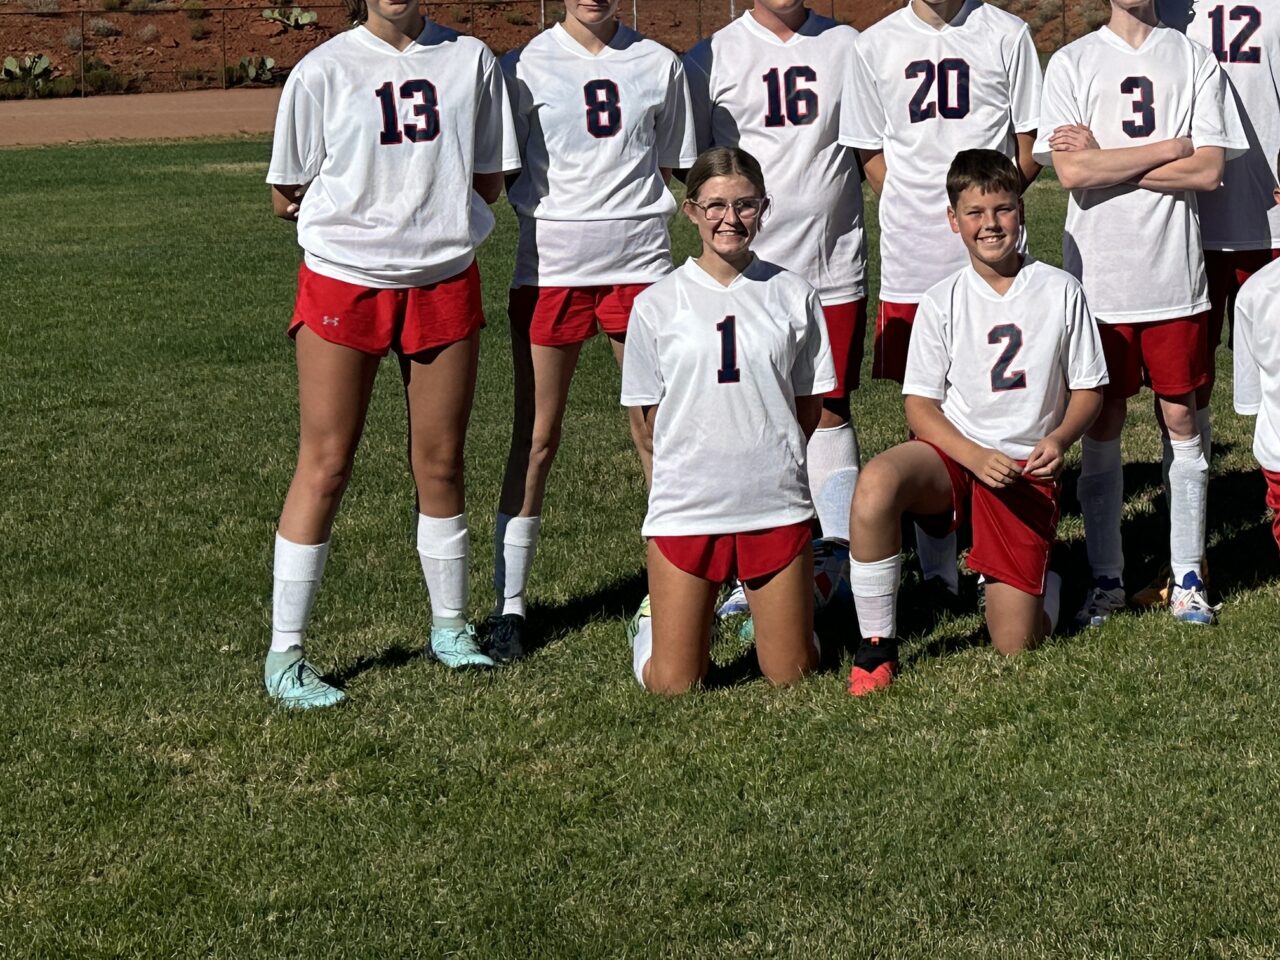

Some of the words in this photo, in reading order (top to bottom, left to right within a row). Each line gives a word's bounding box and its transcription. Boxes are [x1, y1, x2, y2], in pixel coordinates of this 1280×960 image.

[1207, 4, 1262, 64] 12
[374, 78, 441, 146] 13
[583, 78, 622, 139] 8
[762, 65, 819, 128] 16
[904, 57, 970, 124] 20
[1120, 76, 1156, 139] 3
[716, 315, 741, 384] 1
[987, 323, 1027, 393] 2
